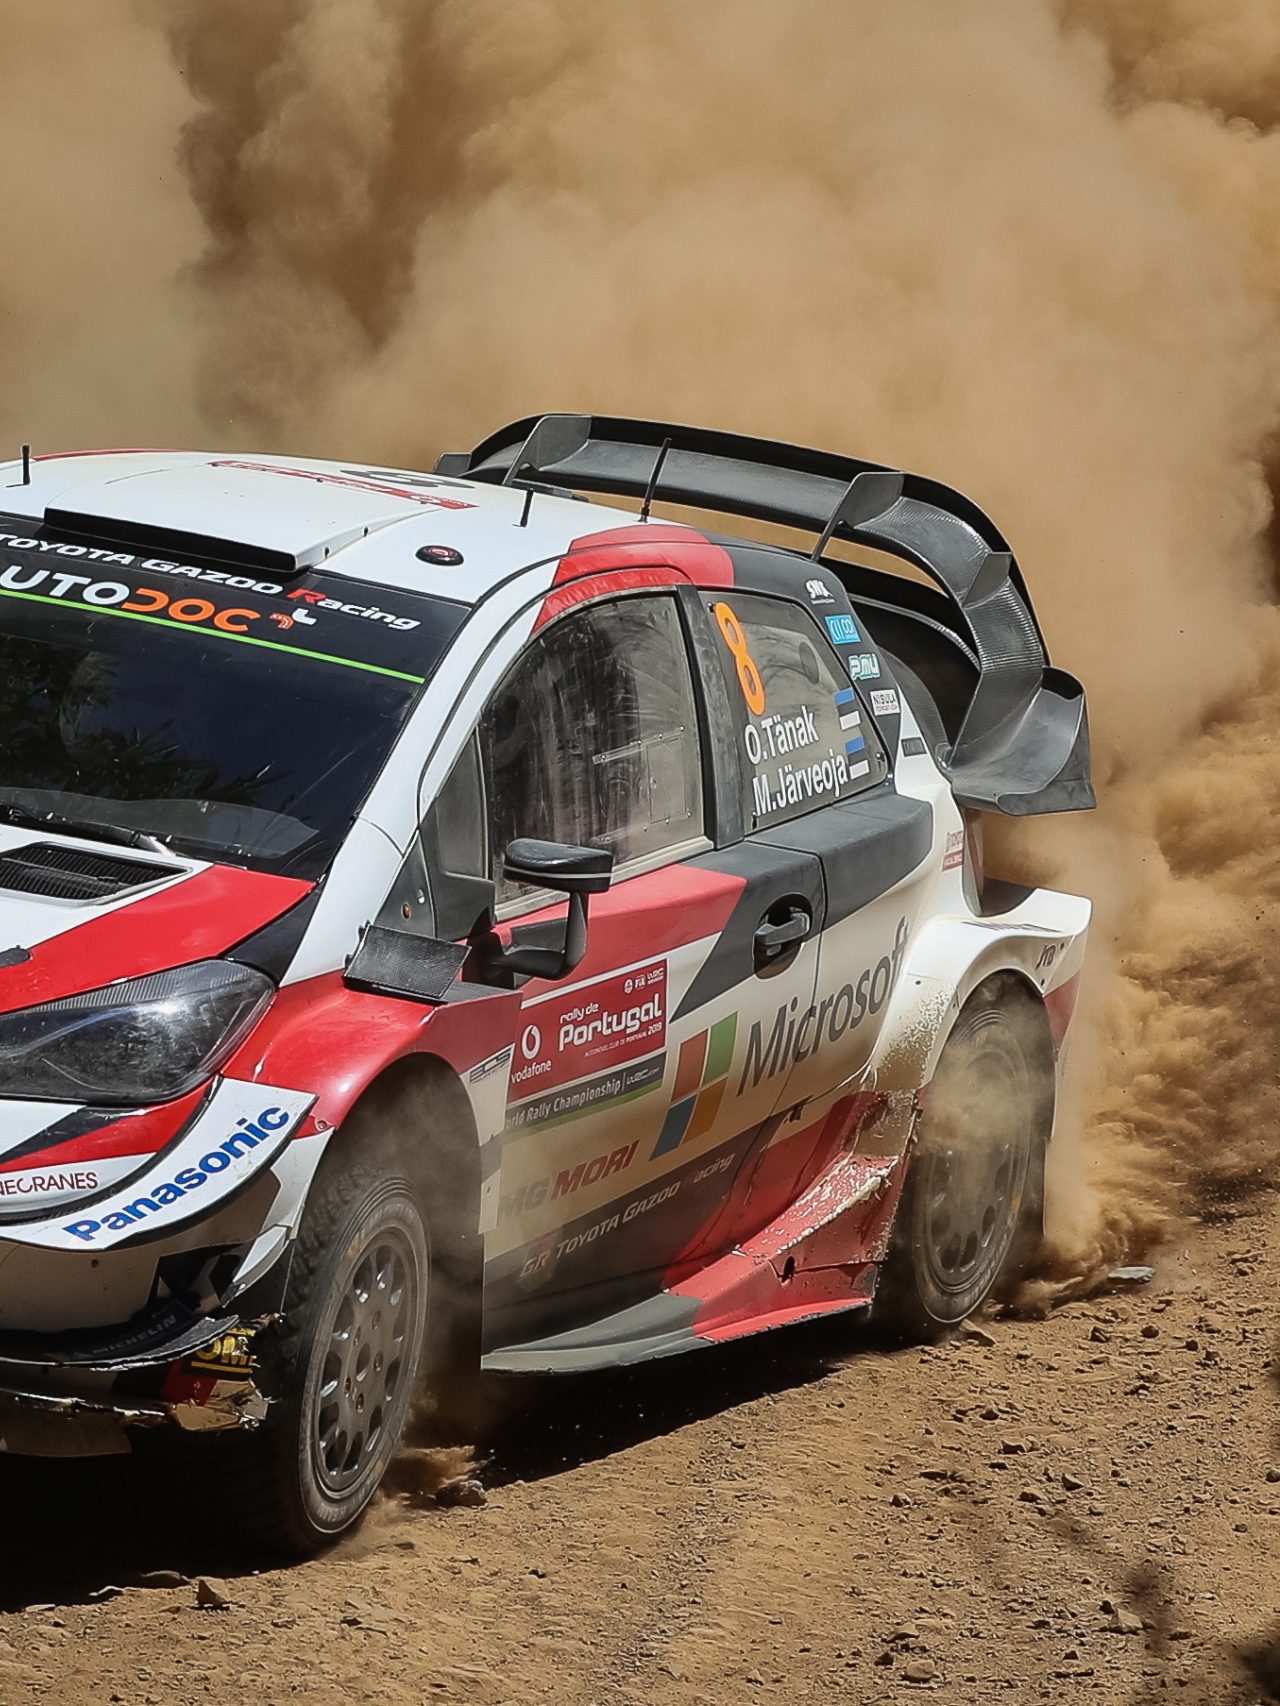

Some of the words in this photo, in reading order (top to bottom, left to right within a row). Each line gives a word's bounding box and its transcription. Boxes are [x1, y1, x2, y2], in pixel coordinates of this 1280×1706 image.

[140, 559, 284, 595] GAZOO
[286, 588, 422, 631] Racing
[713, 602, 766, 716] 8
[744, 704, 820, 765] O.Tänak
[752, 749, 849, 817] M.Järveoja
[559, 993, 663, 1052] Portugal
[560, 1006, 585, 1024] rally
[586, 1002, 600, 1015] de
[736, 915, 910, 1098] Microsof
[505, 1110, 525, 1129] orld
[527, 1103, 551, 1122] Rally
[554, 1078, 621, 1112] Championship
[511, 1060, 552, 1084] vodafone
[63, 1107, 290, 1242] Panasonic
[551, 1140, 640, 1200] MORI
[556, 1214, 620, 1259] TOYOTA
[622, 1181, 682, 1223] GAZOO
